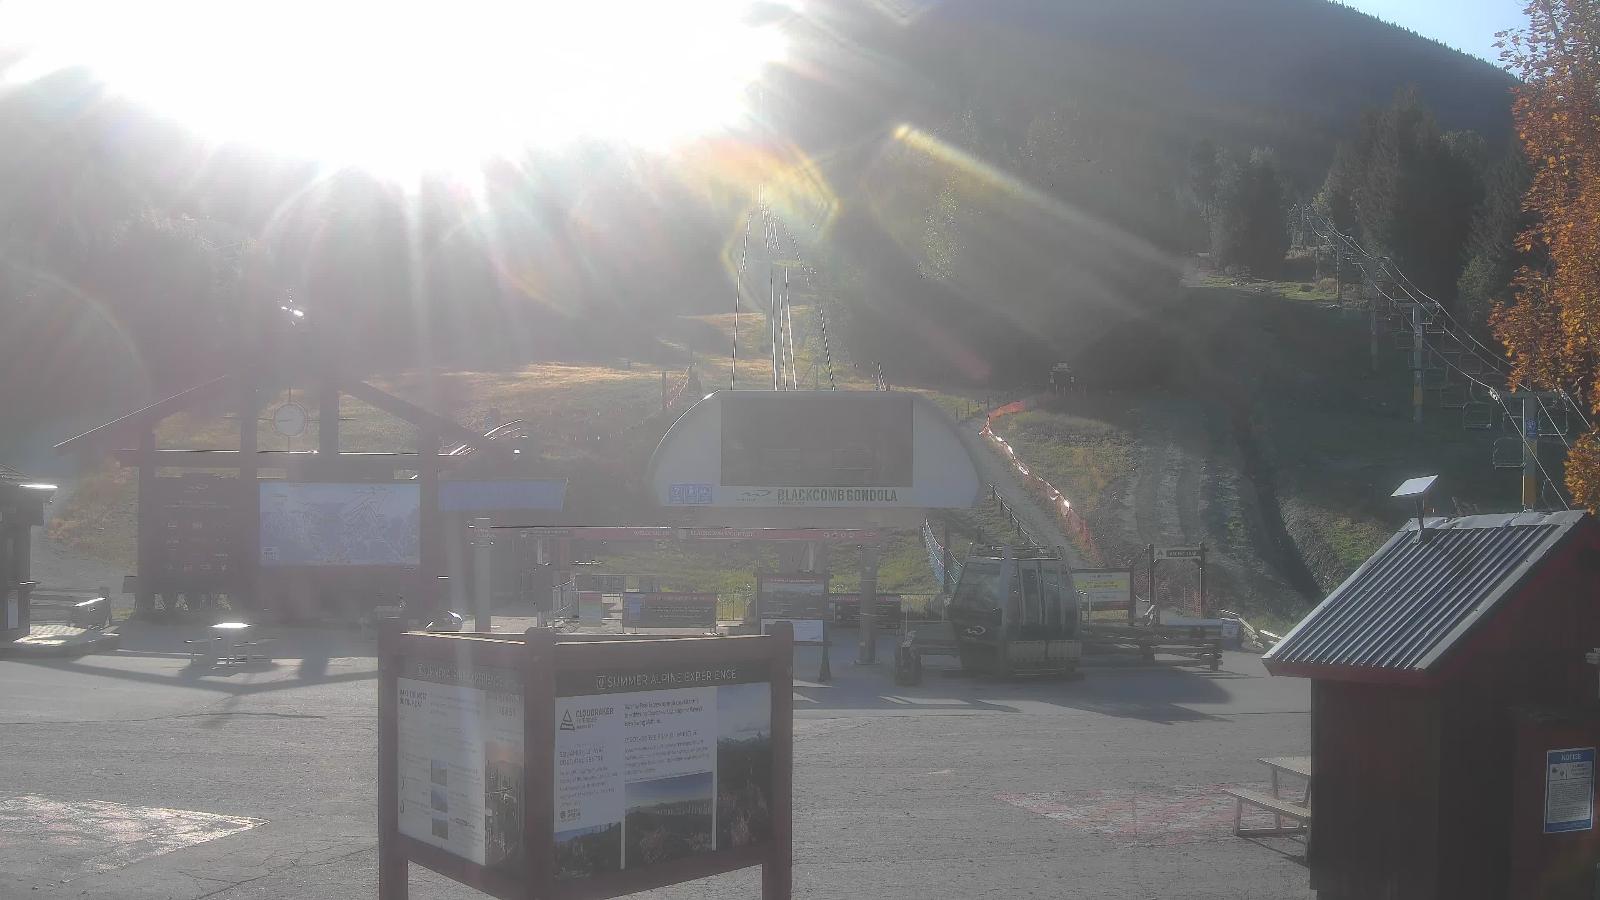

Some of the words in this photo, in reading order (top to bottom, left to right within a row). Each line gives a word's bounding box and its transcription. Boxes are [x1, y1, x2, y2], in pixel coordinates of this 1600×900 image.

[777, 488, 844, 502] BLACKCOMB
[846, 488, 898, 502] GONDOLA
[607, 673, 648, 688] SUMMER
[650, 672, 682, 685] ALPINE
[684, 669, 737, 682] EXPERIENCE
